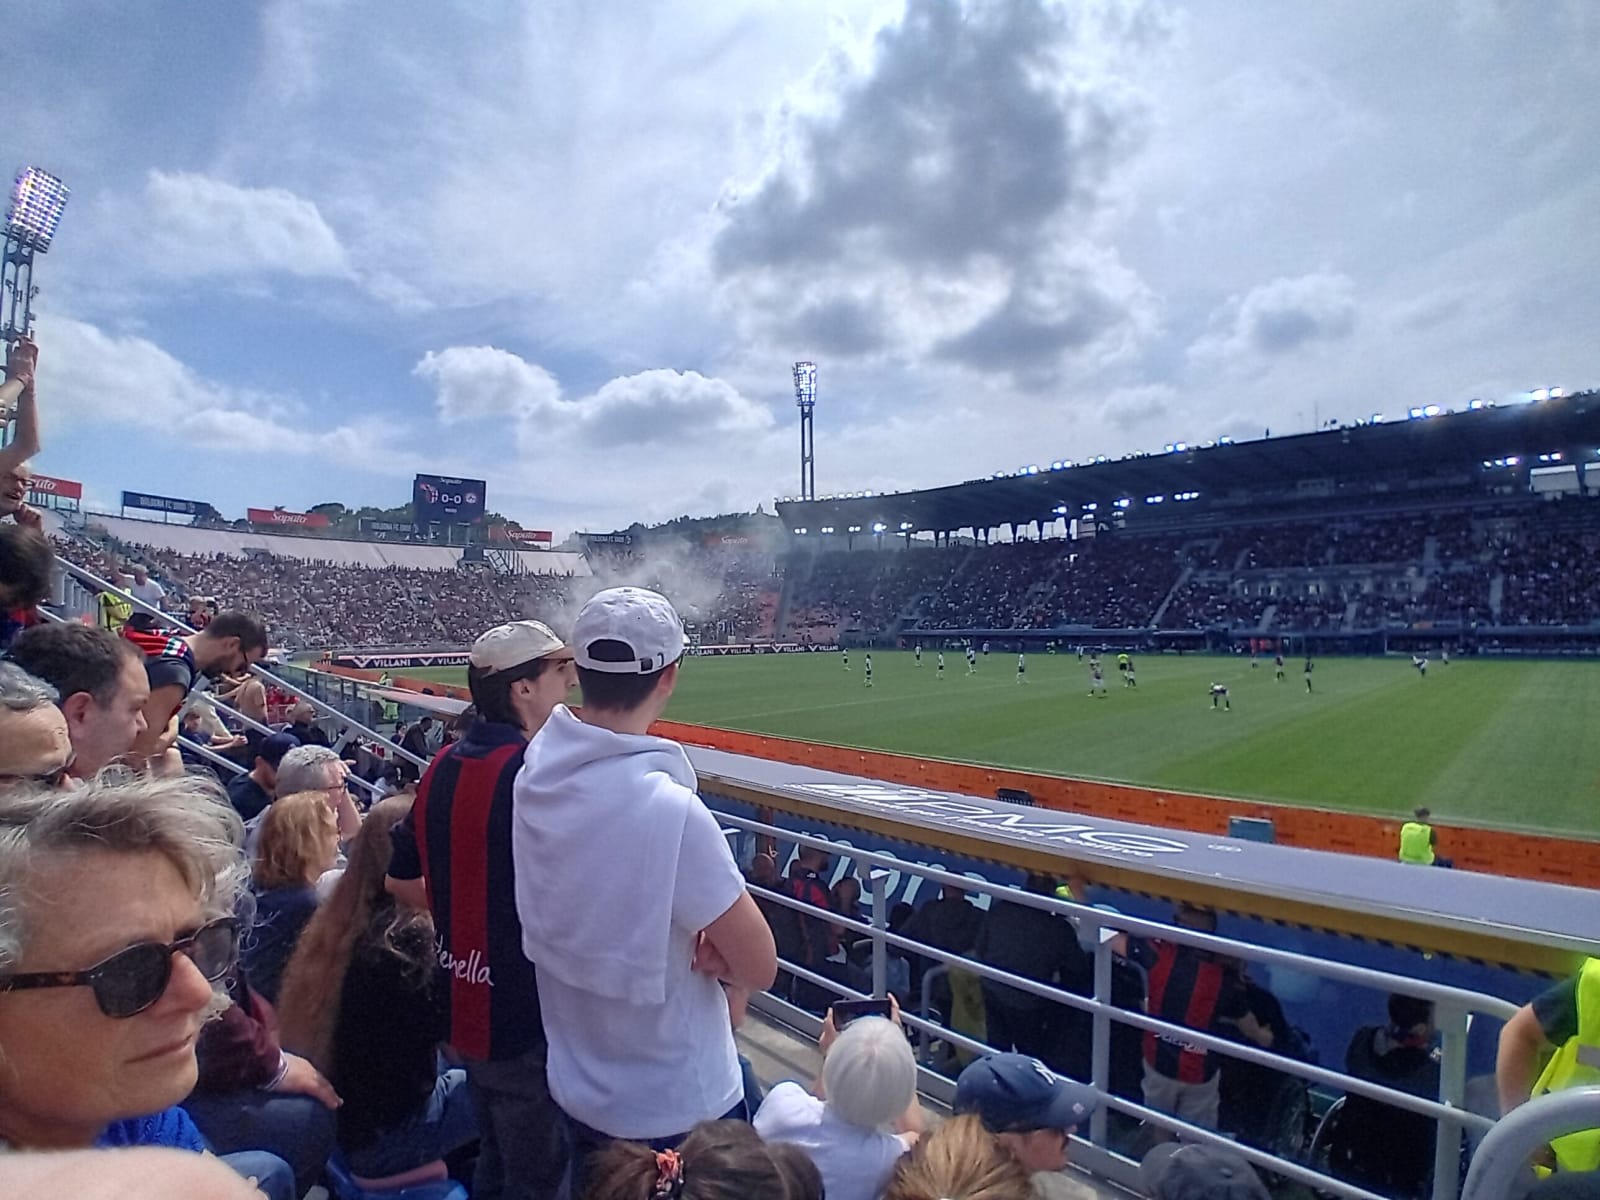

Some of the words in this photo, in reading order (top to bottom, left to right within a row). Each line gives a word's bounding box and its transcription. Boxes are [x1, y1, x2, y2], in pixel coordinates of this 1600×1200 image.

[441, 494, 462, 504] 0-0
[271, 511, 308, 525] Saputo
[507, 529, 537, 540] Saputo
[373, 658, 411, 667] VILLANI
[437, 656, 470, 665] VILLAN
